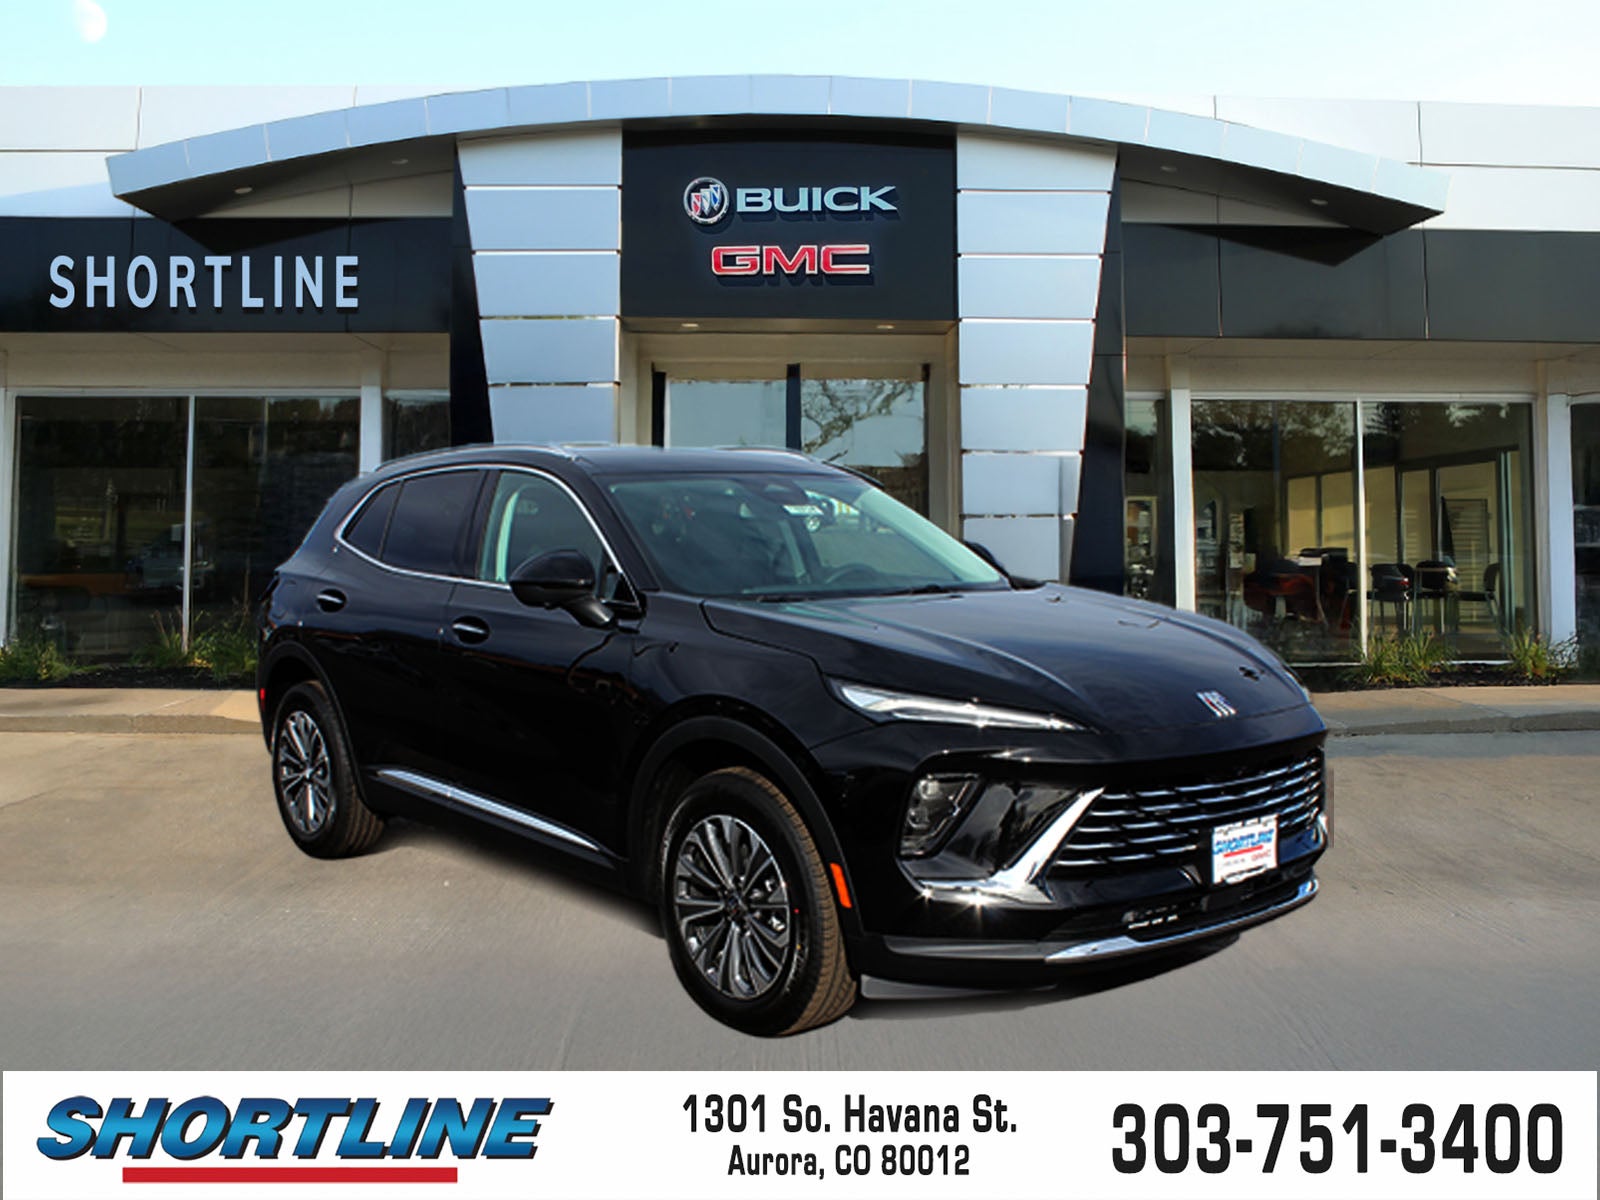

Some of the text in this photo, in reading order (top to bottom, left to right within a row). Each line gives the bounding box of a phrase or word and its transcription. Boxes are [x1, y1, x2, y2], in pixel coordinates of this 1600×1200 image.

[736, 185, 898, 212] BUICK
[711, 244, 870, 276] GMC
[49, 255, 360, 309] SHORTLINE
